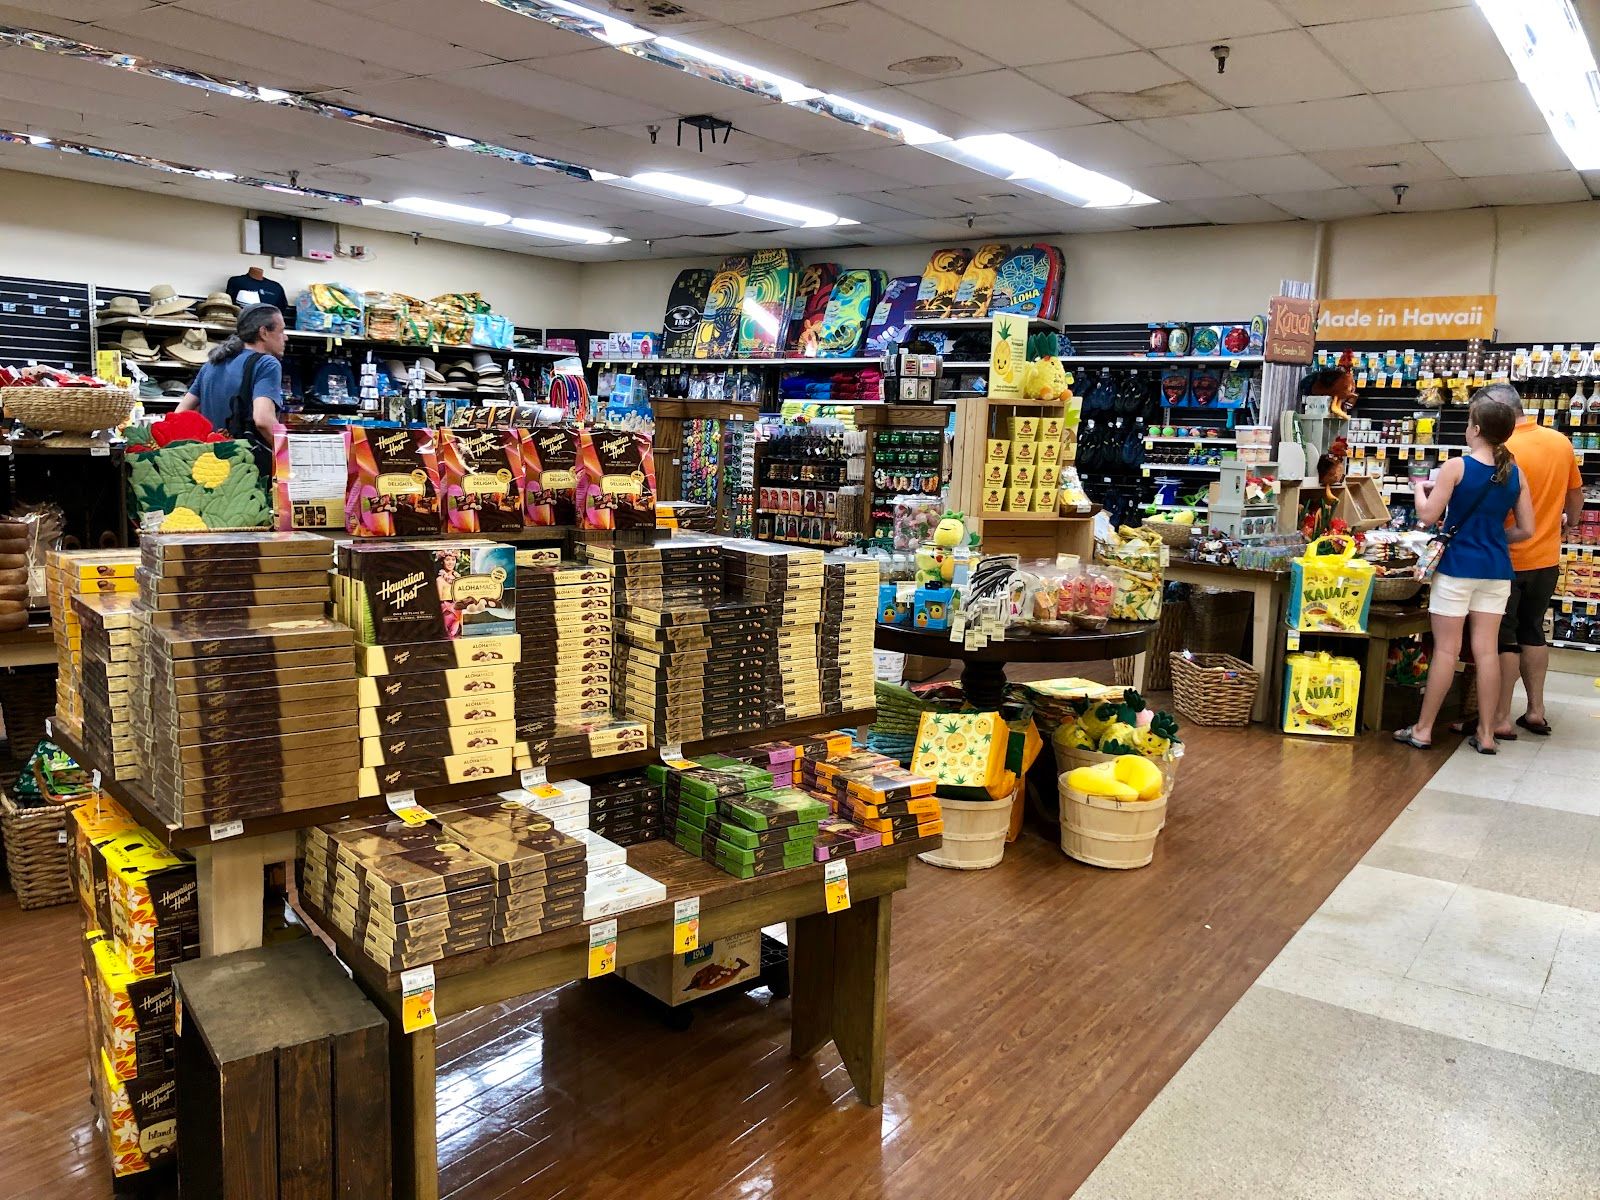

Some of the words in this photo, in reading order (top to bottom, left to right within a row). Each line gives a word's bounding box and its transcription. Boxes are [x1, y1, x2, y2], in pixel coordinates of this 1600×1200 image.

[1008, 288, 1041, 306] LOHA
[1317, 310, 1371, 328] Made
[1376, 308, 1397, 327] in
[1402, 306, 1483, 327] Hawaii
[375, 431, 408, 449] Hawaiian
[386, 439, 410, 456] Host
[539, 433, 566, 449] Hawaiian
[547, 440, 568, 456] Host
[600, 436, 630, 453] Hawaiian
[609, 443, 631, 460] Host
[376, 571, 425, 600] Hawaiian
[390, 582, 428, 609] Host
[1303, 587, 1349, 603] KAUAI
[159, 881, 197, 906] Hawaiian
[169, 889, 198, 911] Host
[150, 994, 173, 1015] Host
[137, 1080, 175, 1105] Hawaiian
[148, 1088, 176, 1111] Host
[148, 1126, 173, 1140] Island
